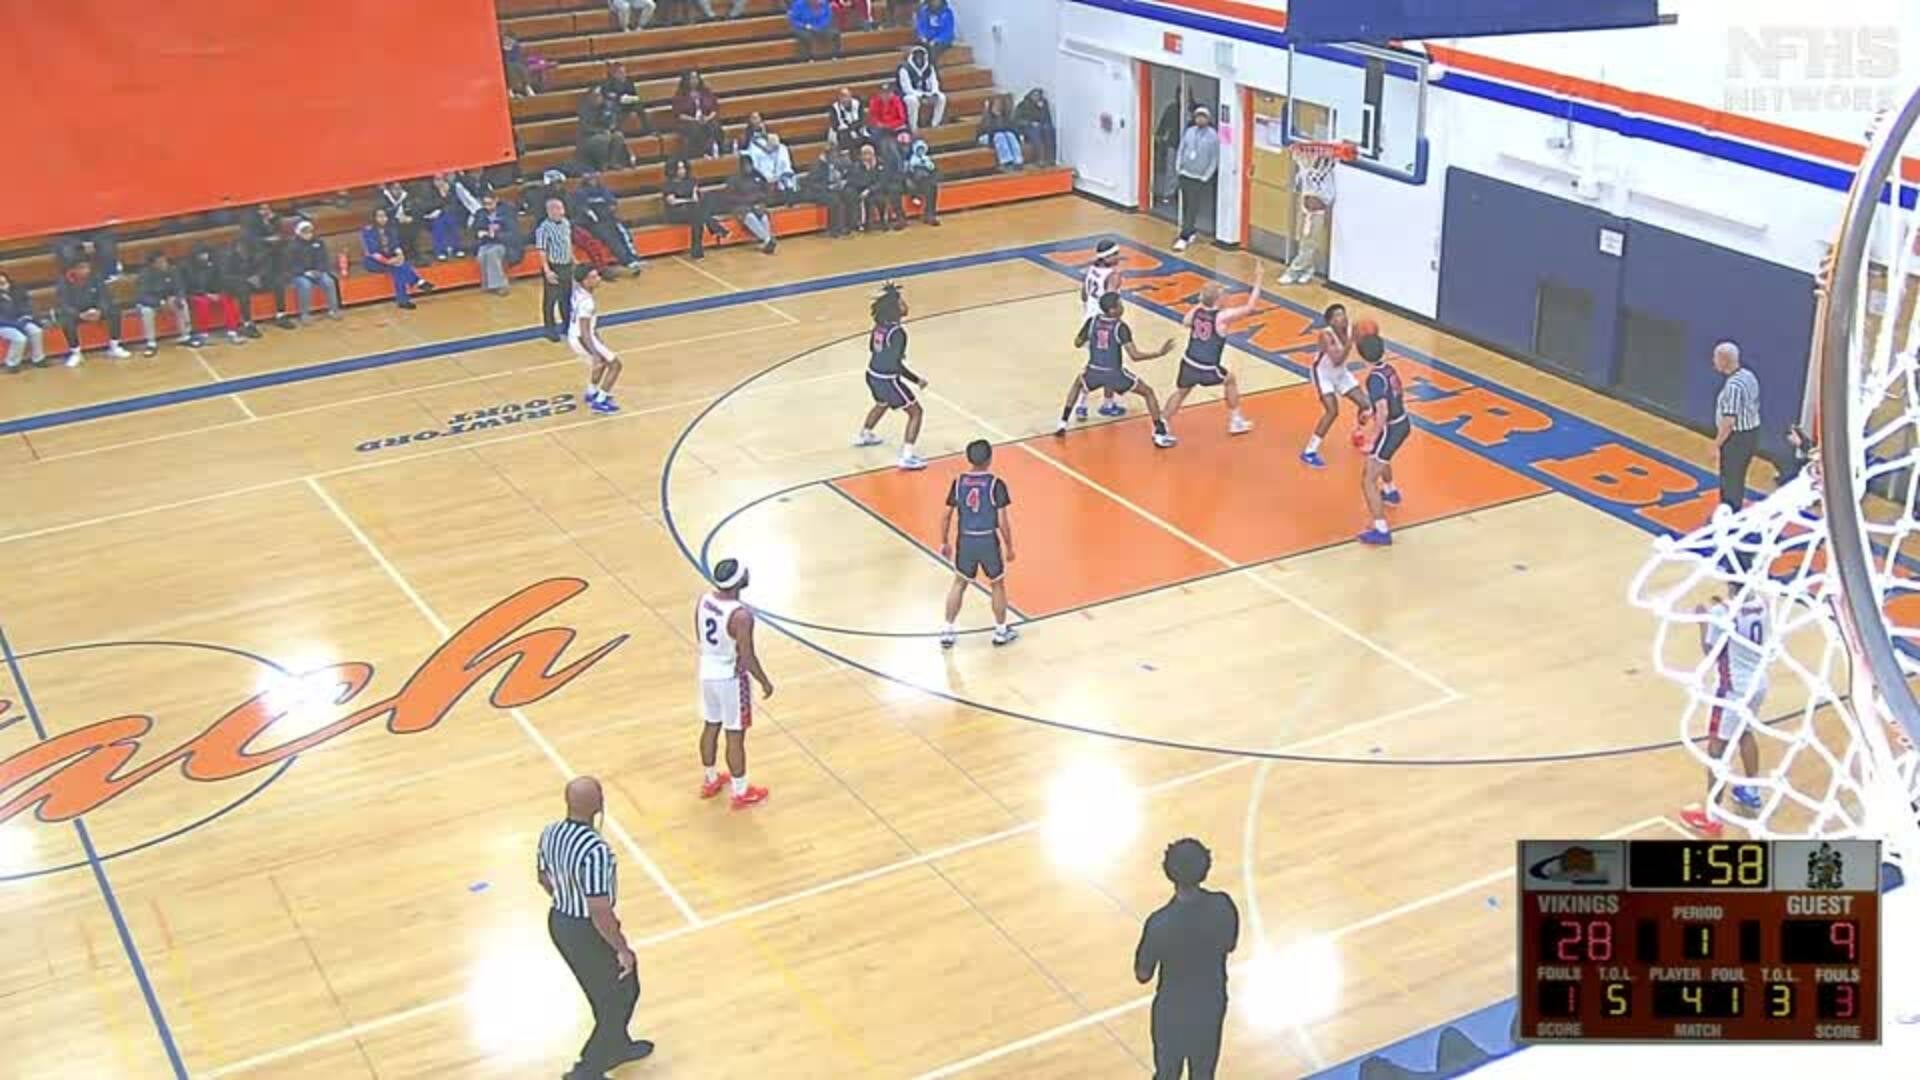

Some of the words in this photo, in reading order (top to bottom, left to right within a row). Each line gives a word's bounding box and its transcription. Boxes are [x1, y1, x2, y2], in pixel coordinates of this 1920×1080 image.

[448, 394, 575, 424] COURT
[356, 403, 577, 452] CRAWFORD
[966, 488, 980, 513] 4
[705, 617, 718, 646] 2
